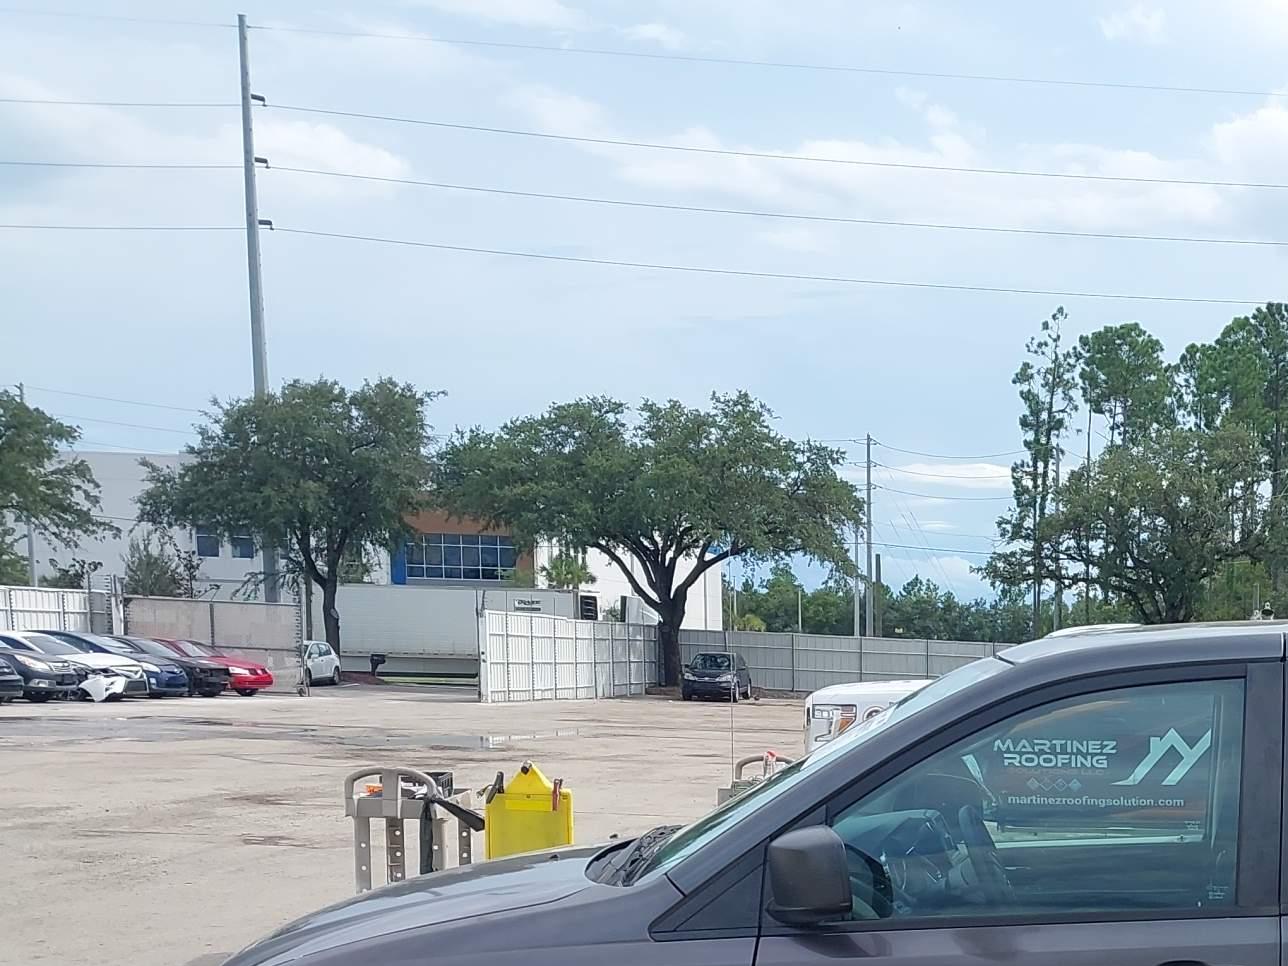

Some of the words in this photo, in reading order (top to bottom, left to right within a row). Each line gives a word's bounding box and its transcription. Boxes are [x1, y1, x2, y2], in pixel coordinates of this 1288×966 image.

[993, 739, 1117, 754] MARTINEZ
[1003, 753, 1108, 768] ROOFING
[1007, 794, 1184, 808] martinezroofingsolution.com
